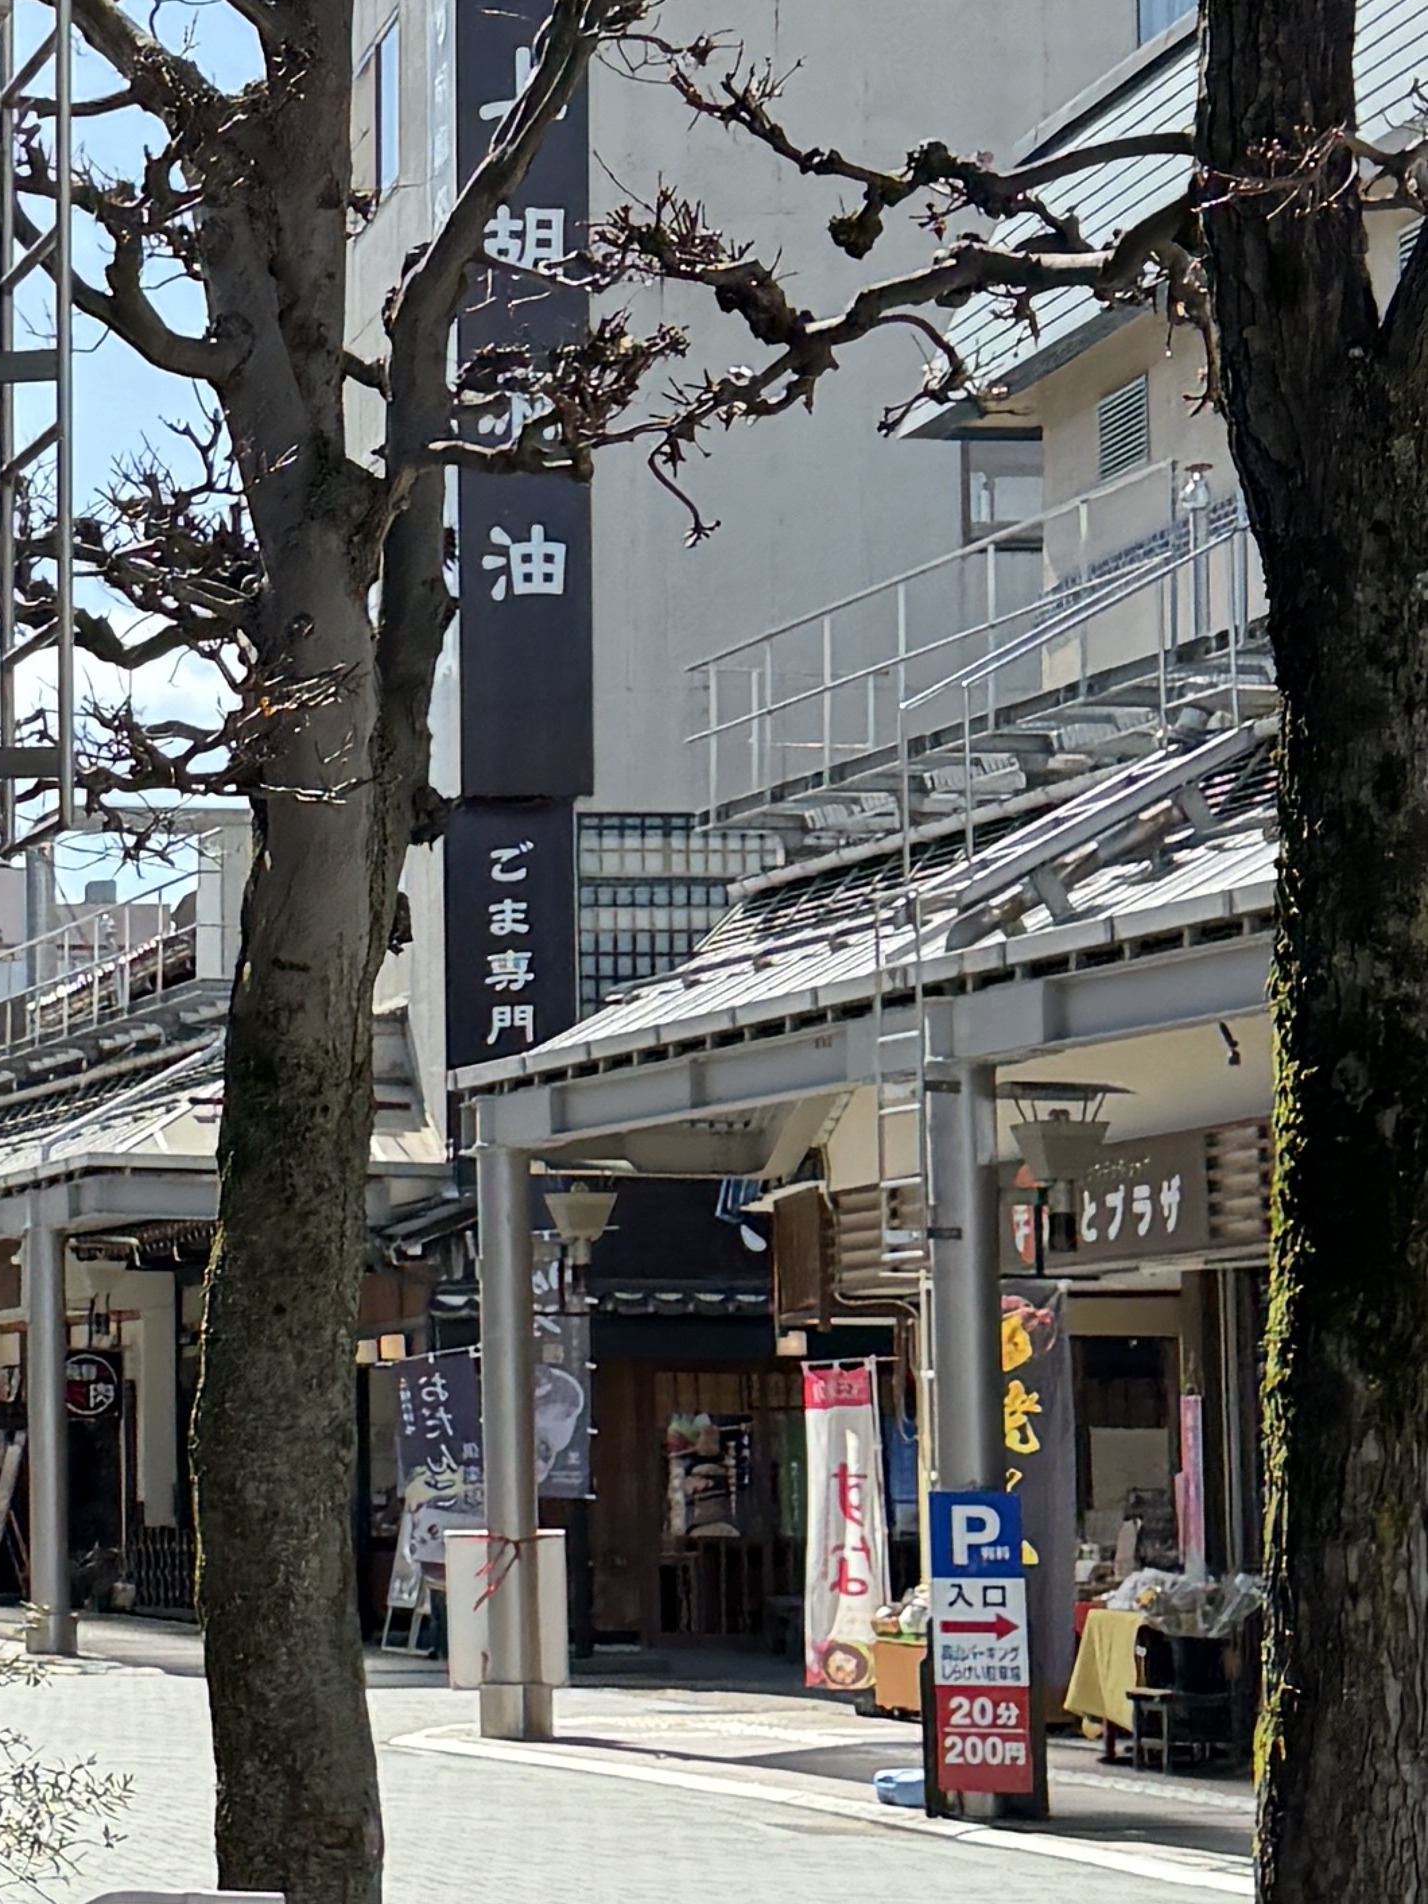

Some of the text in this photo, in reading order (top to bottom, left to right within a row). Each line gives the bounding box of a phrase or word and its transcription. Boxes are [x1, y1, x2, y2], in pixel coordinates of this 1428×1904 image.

[484, 840, 535, 1046] ごま専門
[950, 1504, 1001, 1566] P
[948, 1583, 1007, 1608] 入口
[948, 1696, 1020, 1726] 20分
[944, 1736, 1026, 1765] 200円
